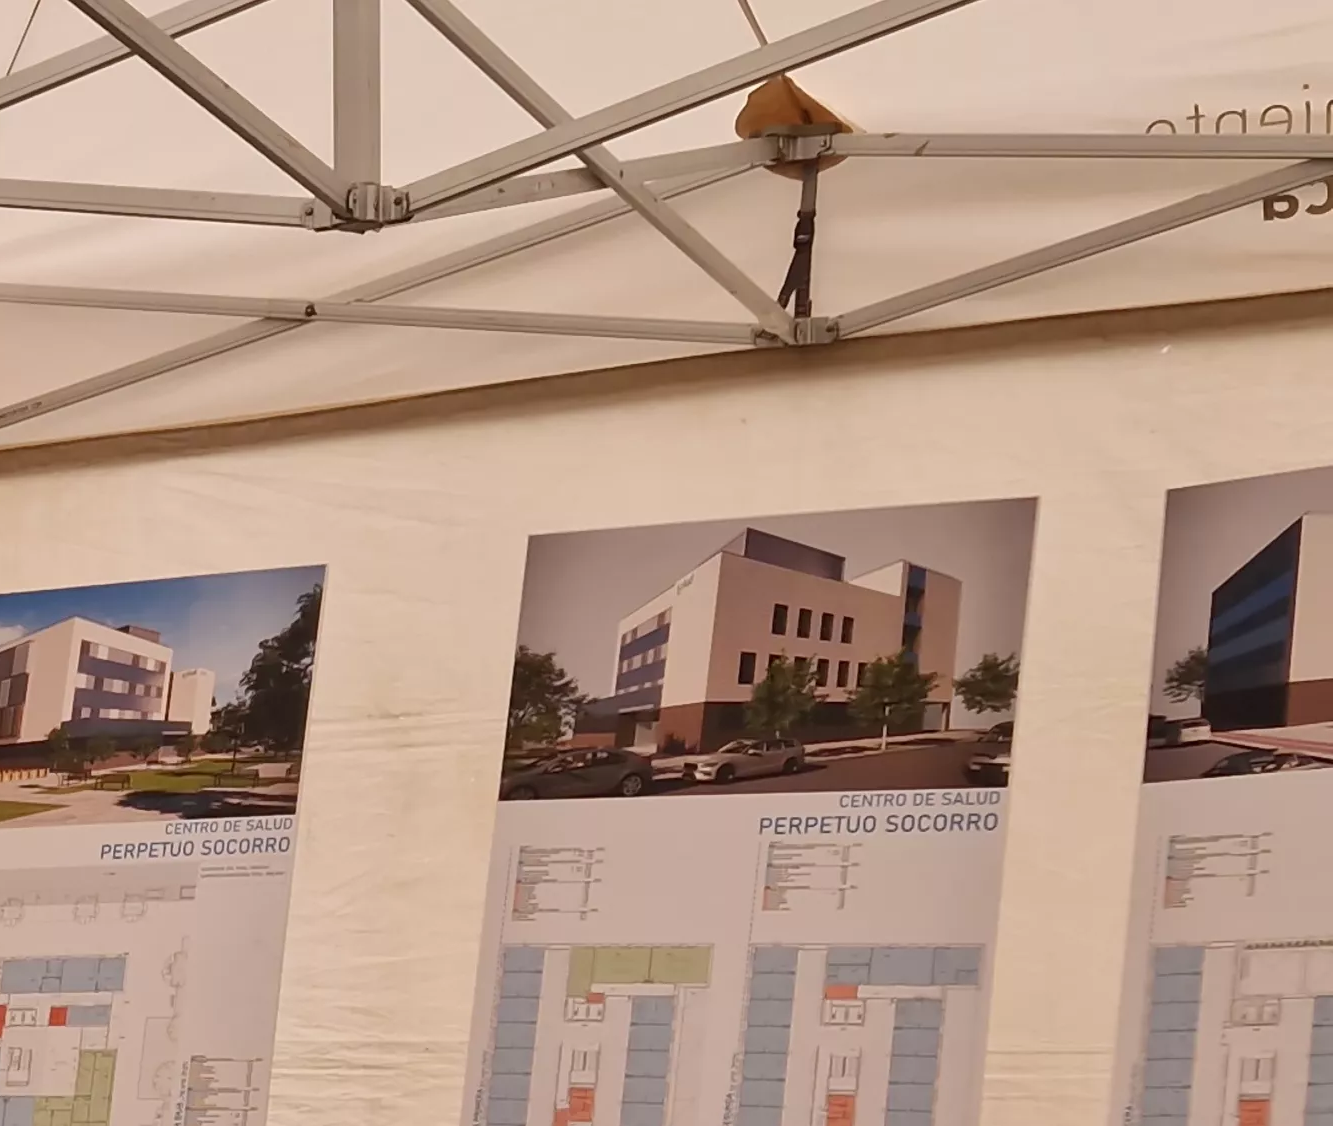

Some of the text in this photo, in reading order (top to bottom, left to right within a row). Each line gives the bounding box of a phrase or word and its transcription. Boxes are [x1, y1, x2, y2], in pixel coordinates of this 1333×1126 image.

[839, 790, 1001, 808] CENTRO DE SALUD
[164, 817, 294, 835] CENTRO DE SALUD
[759, 812, 999, 835] PERPETUO SOCORRO
[100, 836, 291, 860] PERPETUO SOCORRO
